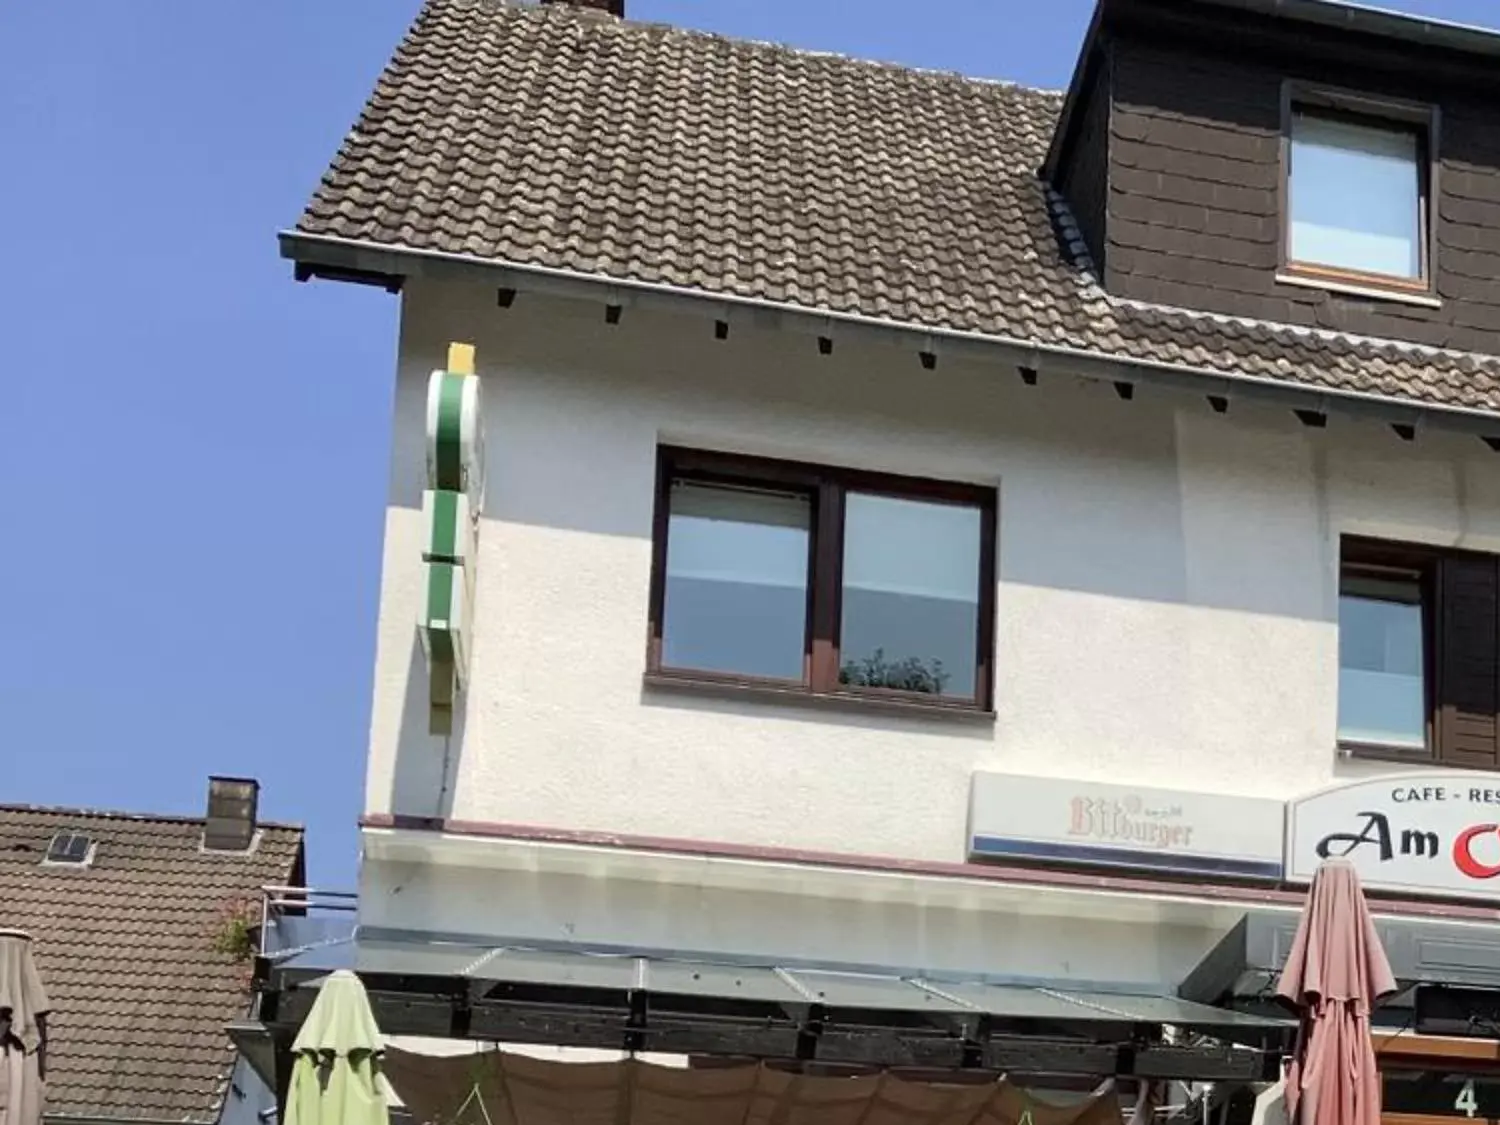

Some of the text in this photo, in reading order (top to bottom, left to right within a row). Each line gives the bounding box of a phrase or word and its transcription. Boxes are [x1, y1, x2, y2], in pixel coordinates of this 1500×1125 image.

[1391, 787, 1447, 803] CAFE
[1316, 811, 1440, 862] Am
[1454, 1079, 1478, 1118] 4
